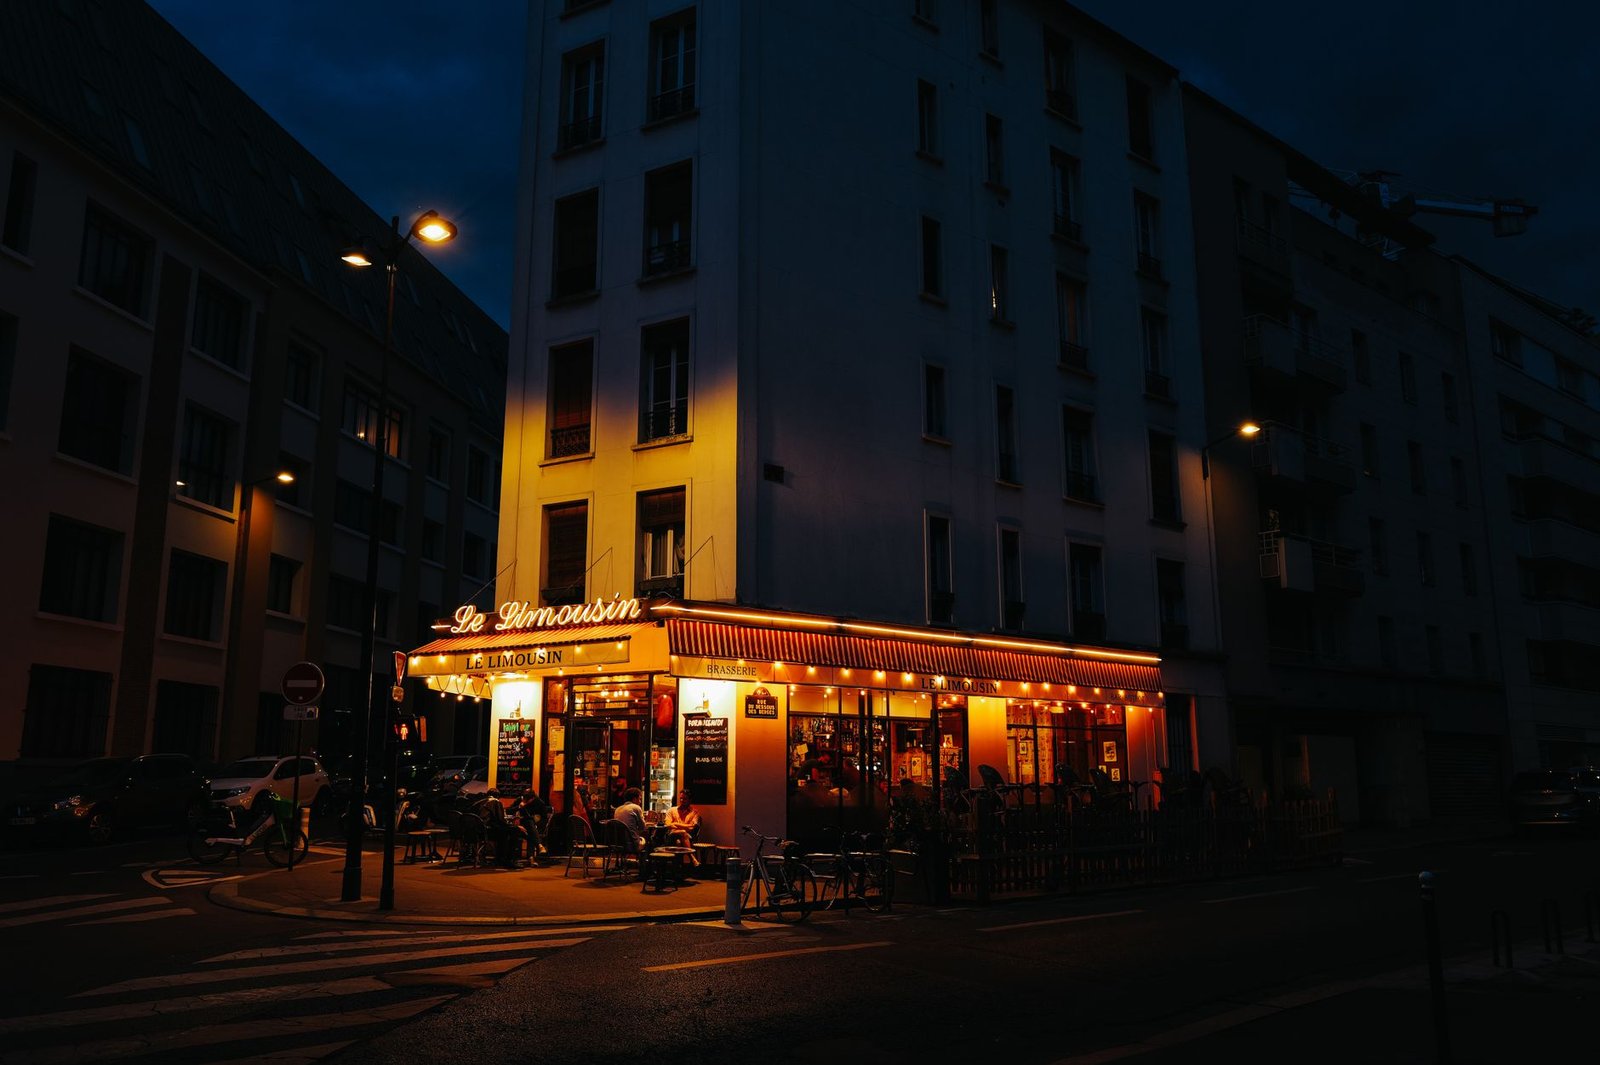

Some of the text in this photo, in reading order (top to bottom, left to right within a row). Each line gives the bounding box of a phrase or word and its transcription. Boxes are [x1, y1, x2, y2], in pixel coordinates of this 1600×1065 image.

[451, 592, 642, 634] Le Limousin
[466, 650, 563, 670] LE LIMOUSIN
[707, 664, 757, 677] BRASSERIE
[921, 677, 998, 694] LE LIMOUSIN
